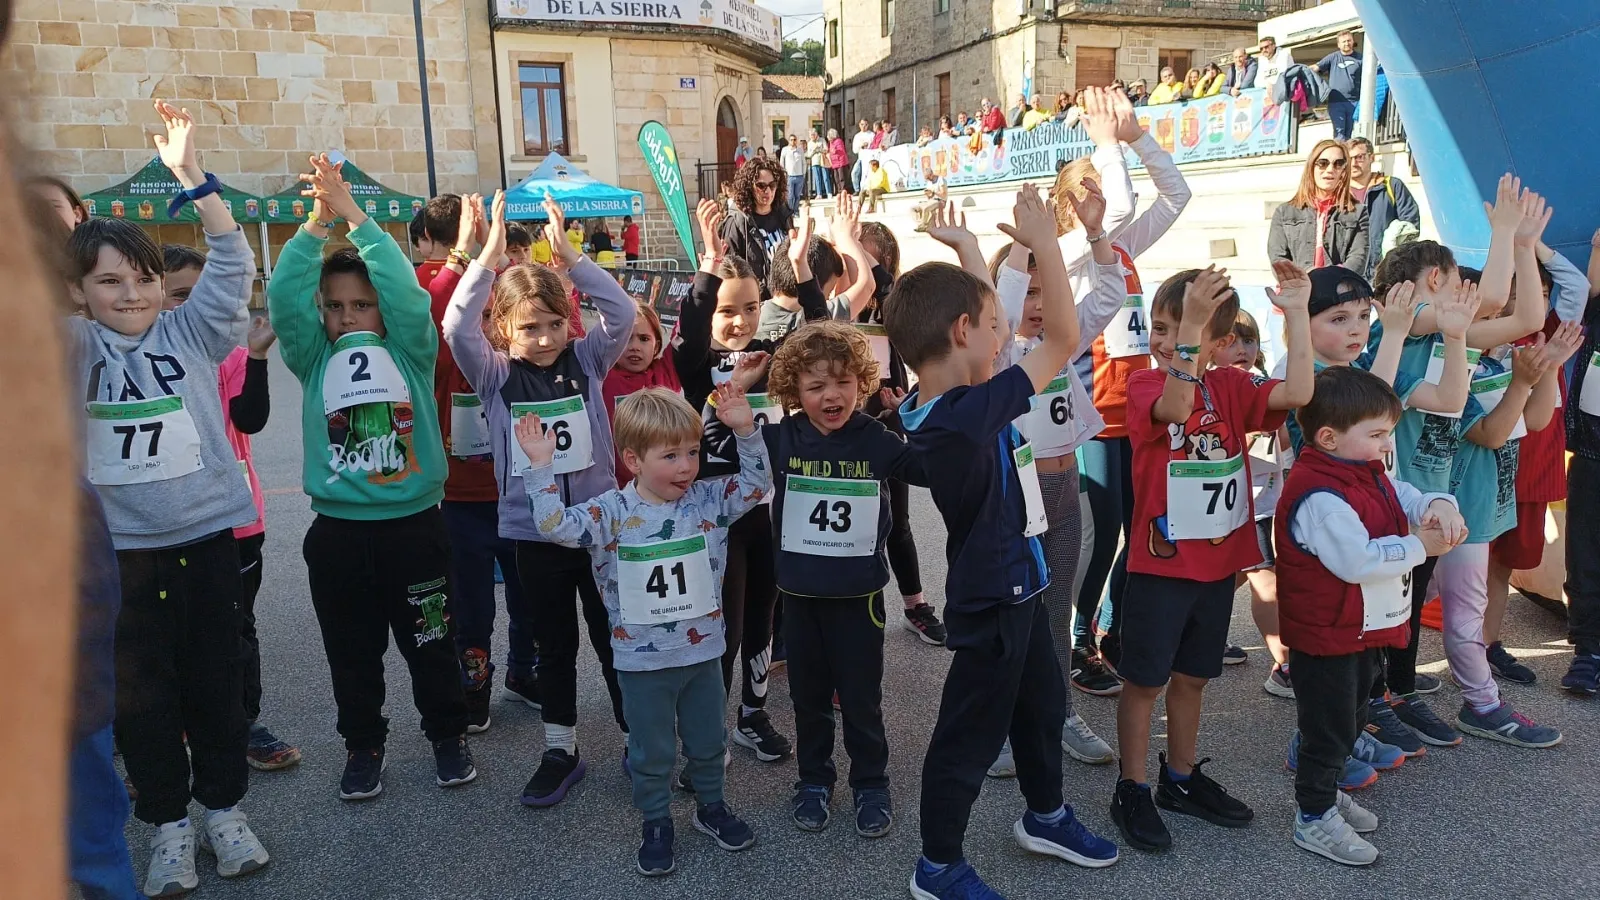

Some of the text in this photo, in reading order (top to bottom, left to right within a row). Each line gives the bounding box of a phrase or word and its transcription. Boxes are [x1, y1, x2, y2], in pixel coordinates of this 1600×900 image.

[547, 0, 682, 19] DE LA SIERRA
[723, 11, 734, 28] DE
[1010, 149, 1051, 176] SIERRA
[575, 201, 590, 212] LA
[591, 200, 628, 211] SIERRA
[348, 351, 372, 383] 2
[113, 421, 163, 460] 77
[801, 460, 874, 478] WILD TRAIL
[1202, 478, 1238, 515] 70
[809, 499, 852, 533] 43
[645, 561, 687, 599] 41
[1385, 611, 1399, 619] HUGO
